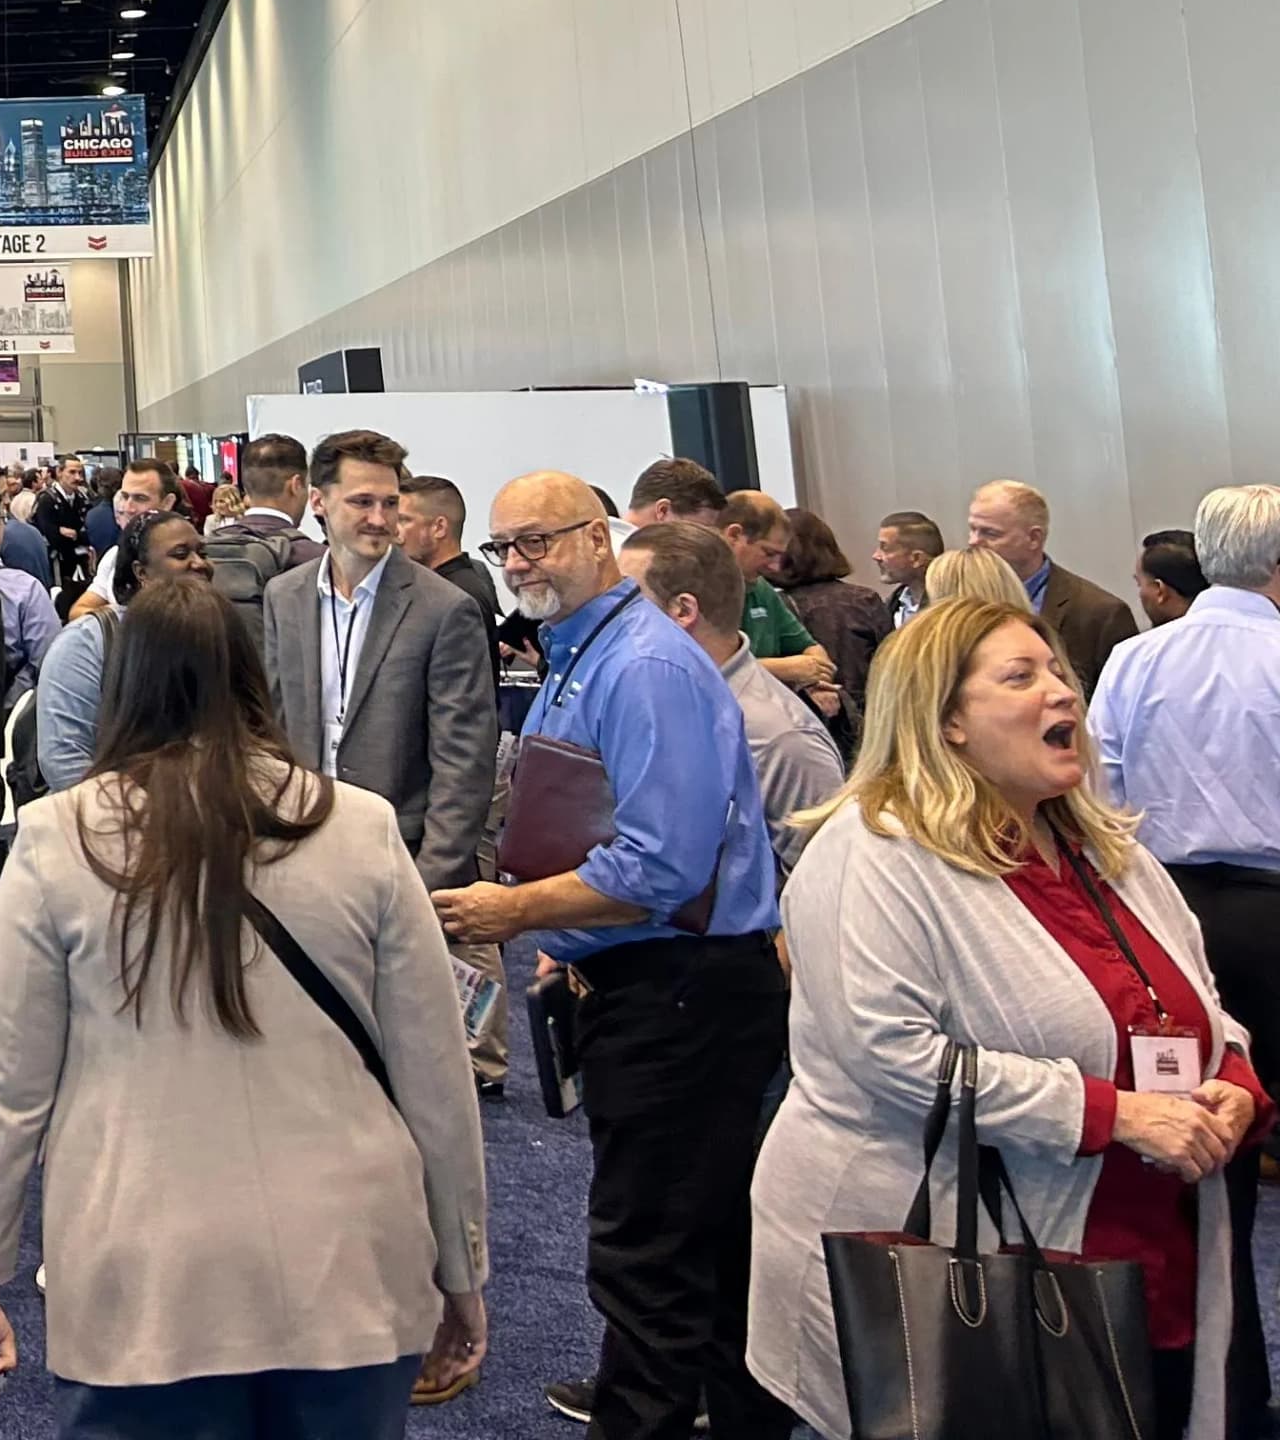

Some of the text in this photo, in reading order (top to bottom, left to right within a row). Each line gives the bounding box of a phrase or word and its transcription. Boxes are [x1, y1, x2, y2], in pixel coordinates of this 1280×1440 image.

[63, 138, 134, 150] CHICAGO
[64, 148, 133, 158] BUILD EXPO
[35, 234, 45, 253] 2
[12, 340, 17, 351] 1
